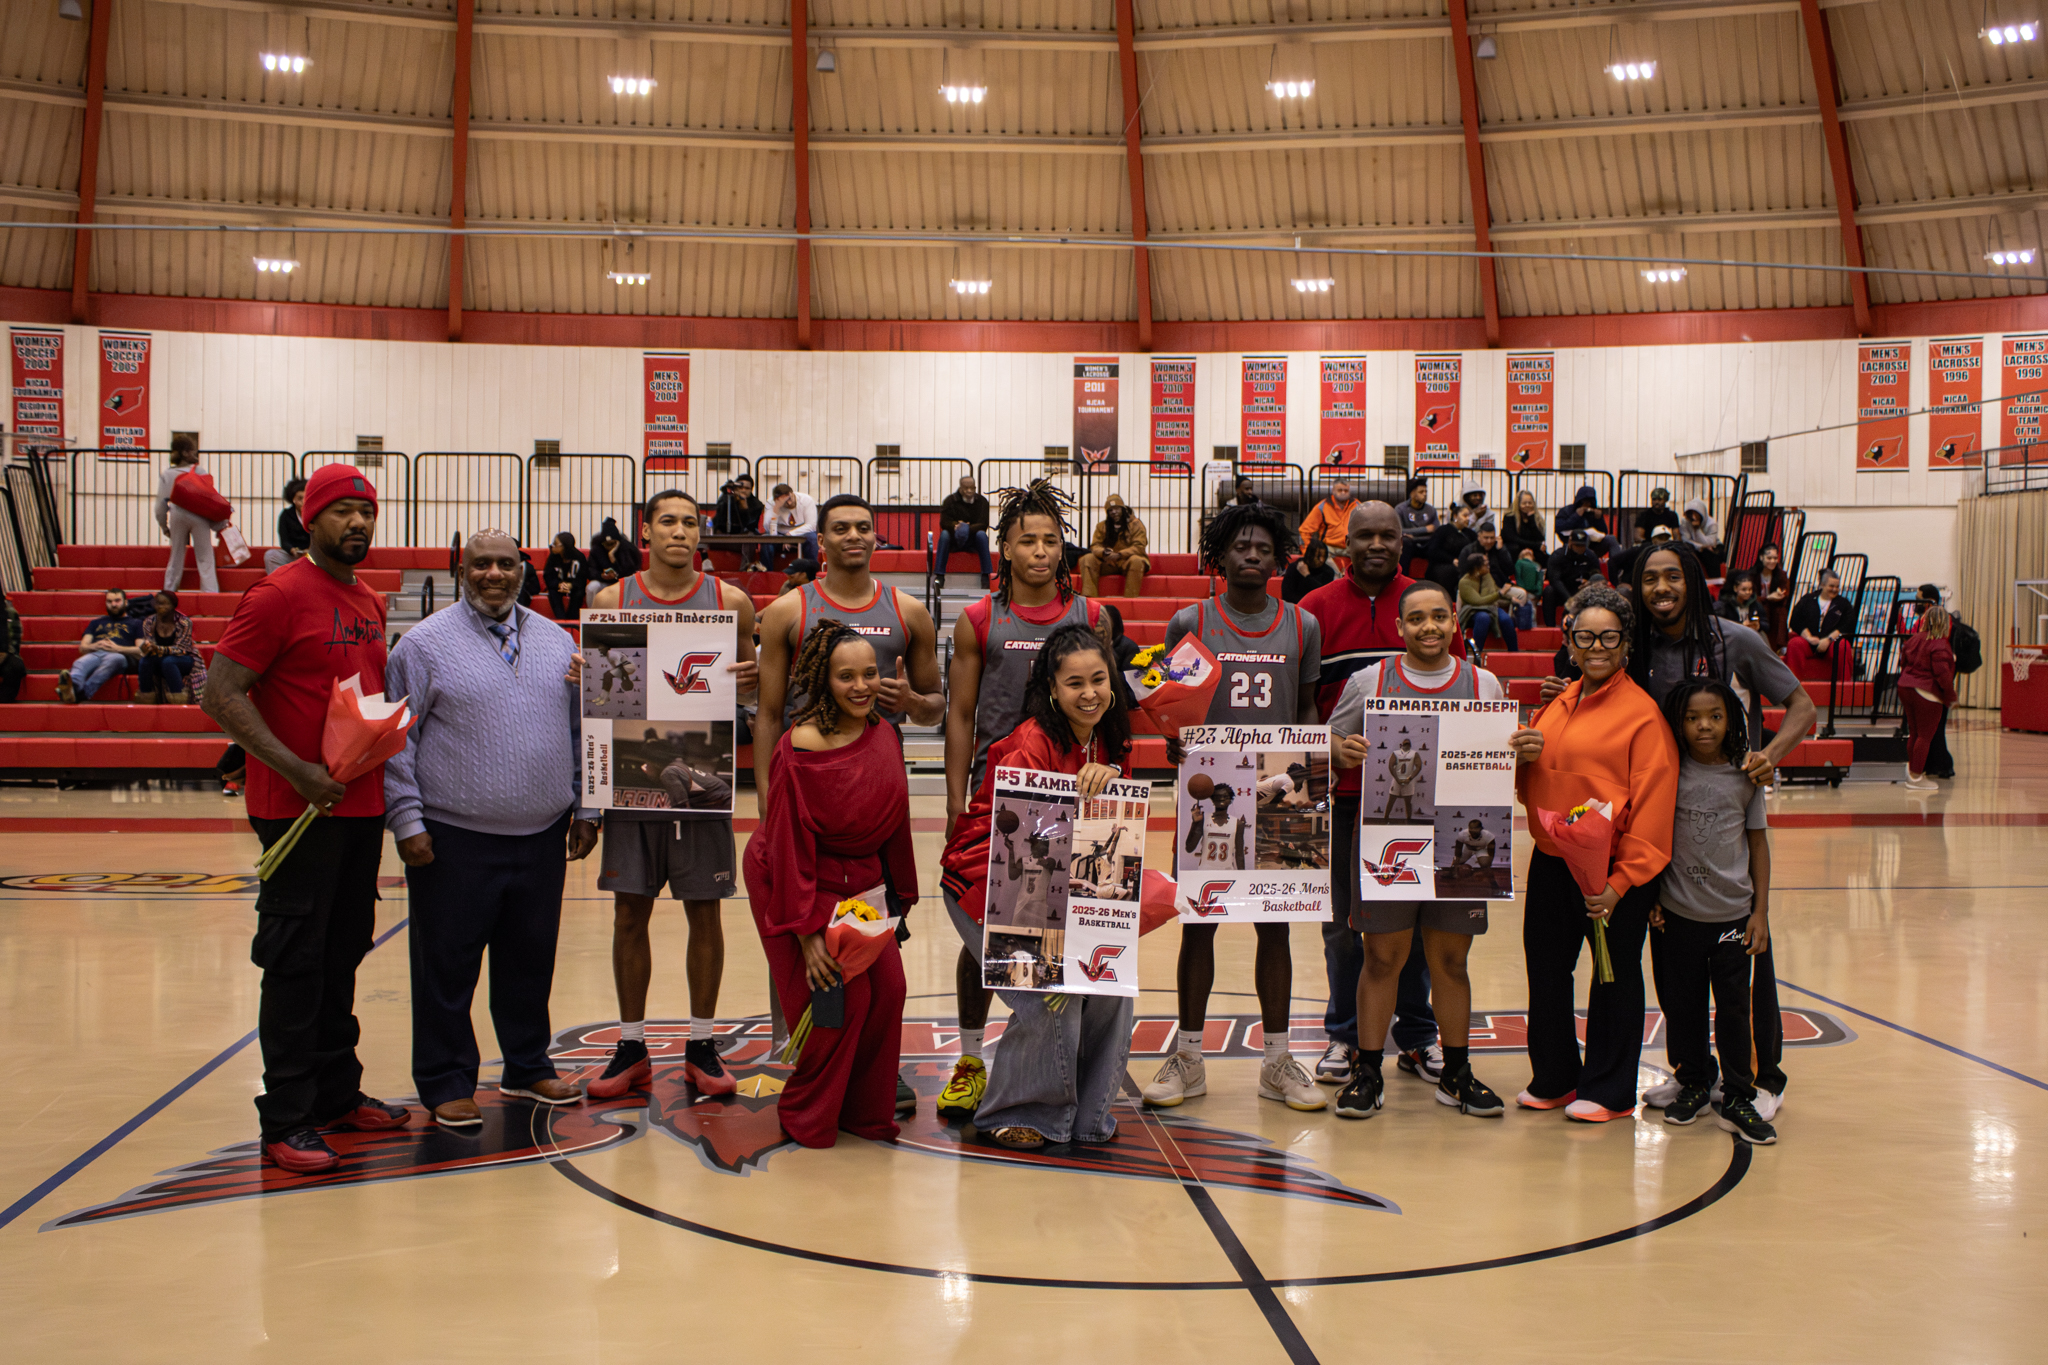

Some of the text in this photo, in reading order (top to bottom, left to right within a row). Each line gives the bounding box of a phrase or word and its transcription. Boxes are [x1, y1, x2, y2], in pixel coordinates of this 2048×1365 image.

[14, 336, 60, 348] WOMEN'S
[103, 339, 148, 351] WOMEN'S
[1941, 345, 1971, 356] MEN'S
[2014, 342, 2044, 353] MEN'S
[18, 347, 57, 359] SOCCER
[106, 350, 144, 362] SOCCER
[1870, 349, 1899, 360] MEN'S
[1510, 360, 1551, 370] WOMEN'S
[1931, 357, 1980, 370] LACROSSE
[2004, 354, 2048, 366] LACROSS
[1154, 363, 1192, 372] WOMEN'S
[1246, 362, 1284, 371] WOMEN'S
[1324, 362, 1363, 372] WOMEN'S
[1418, 362, 1459, 372] WOMEN'S
[1861, 361, 1908, 372] LACROSSE
[653, 371, 679, 381] MEN'S
[1153, 373, 1194, 383] LACROSSE
[1245, 372, 1285, 382] LACROSSE
[1323, 372, 1364, 382] LACROSSE
[1416, 372, 1460, 382] LACROSSE
[1508, 371, 1552, 382] LACROSSE
[1943, 371, 1969, 382] 1996
[2016, 368, 2042, 379] 1996
[1871, 374, 1898, 385] 2003
[650, 381, 683, 392] SOCCER
[1084, 382, 1106, 392] 2011
[1162, 383, 1183, 394] 2010
[1254, 383, 1275, 392] 2009
[1332, 383, 1354, 392] 2007
[1426, 383, 1450, 392] 2006
[1519, 384, 1542, 394] 1999
[654, 392, 678, 402] 2004
[1872, 398, 1896, 406] NJCAA
[1943, 394, 1968, 404] NJCAA
[2016, 395, 2041, 404] NJCAA
[1152, 406, 1194, 414] TOURNAMENT
[1322, 410, 1365, 418] TOURNAMENT
[1512, 404, 1549, 414] MARYLAND
[1859, 407, 1908, 417] TOURNAMENT
[1931, 405, 1981, 414] TOURNAMENT
[2008, 406, 2048, 415] ACADEMIC
[18, 411, 58, 421] CHAMPION
[655, 415, 676, 423] NJCAA
[2018, 416, 2039, 425] TEAM
[18, 425, 59, 436] MARYLAND
[104, 426, 145, 437] MARYLAND
[645, 424, 688, 432] TOURNAMENT
[1512, 423, 1549, 433] CHAMPION
[2014, 427, 2040, 436] OF THE
[1155, 430, 1190, 438] CHAMPION
[1155, 445, 1190, 454] MARYLAND
[1415, 452, 1459, 462] TOURNAMENT
[589, 612, 734, 624] #24 Messiah Anderson
[1216, 653, 1287, 664] CATONSVILLE
[1230, 671, 1272, 708] 23
[1388, 700, 1460, 712] AMARIAN
[1463, 702, 1518, 713] JOSEPH
[1183, 727, 1328, 752] #23 Alpha Thiam
[586, 734, 595, 760] Men's
[1440, 751, 1516, 759] 2025-26 MEN'S
[600, 744, 608, 786] Basketball
[996, 769, 1020, 786] #5
[1249, 882, 1330, 896] 2025-26 Men's
[1072, 906, 1110, 916] 2025-26
[1262, 900, 1322, 912] Basketball
